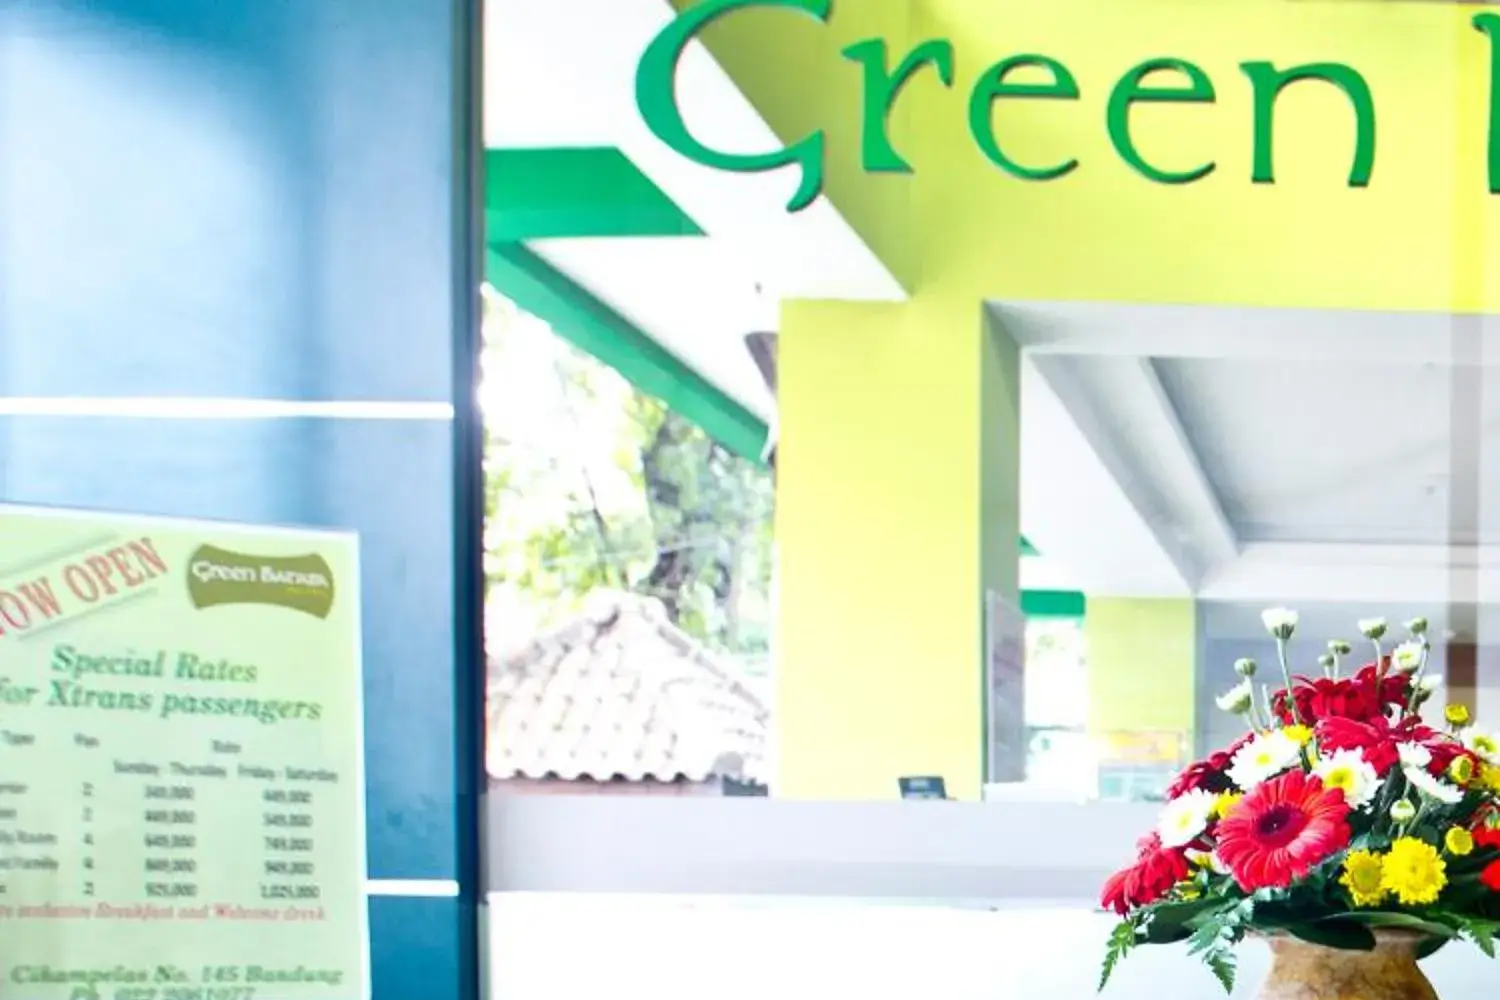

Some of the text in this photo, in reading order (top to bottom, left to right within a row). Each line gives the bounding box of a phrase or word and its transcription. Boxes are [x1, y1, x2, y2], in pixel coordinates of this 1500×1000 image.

[635, 0, 1377, 212] Green
[0, 537, 168, 635] OW OPEN
[191, 560, 257, 583] Green
[51, 645, 258, 683] Special Rates
[47, 680, 153, 711] Xtrans
[160, 691, 322, 724] passengers
[245, 965, 343, 985] Bandung
